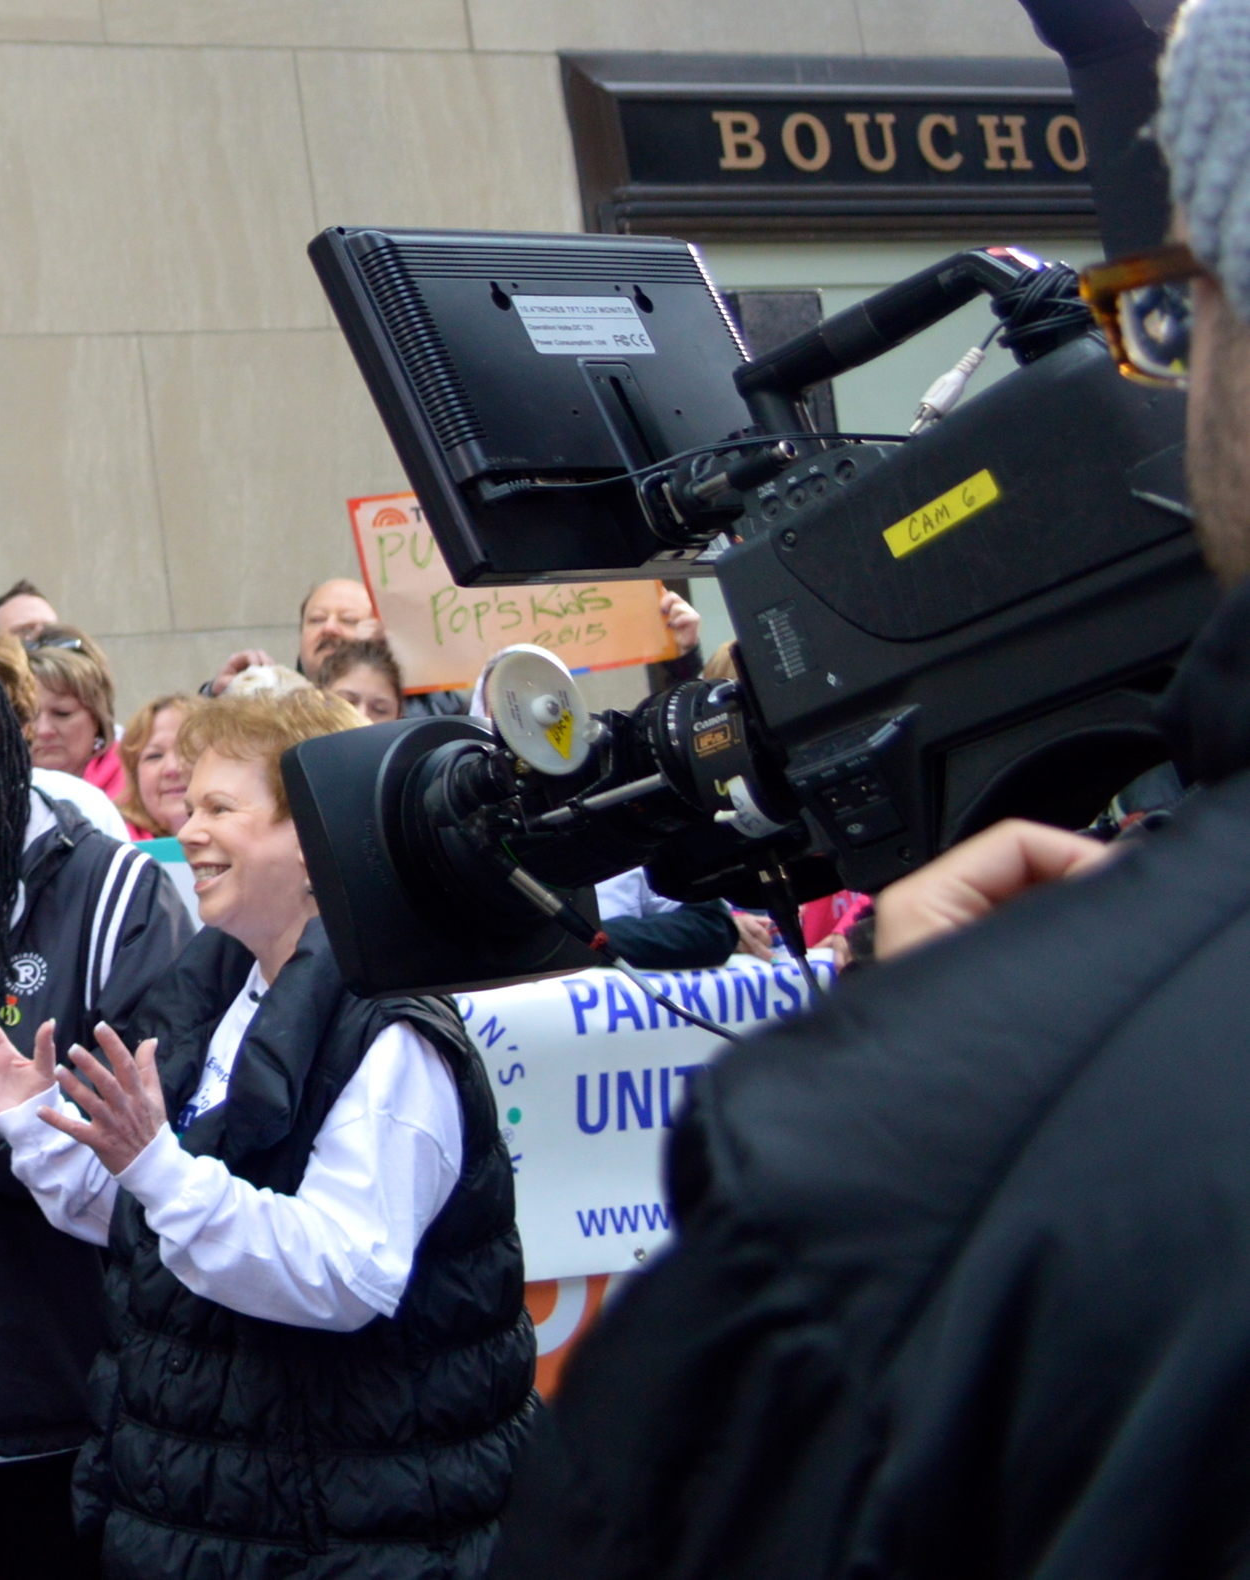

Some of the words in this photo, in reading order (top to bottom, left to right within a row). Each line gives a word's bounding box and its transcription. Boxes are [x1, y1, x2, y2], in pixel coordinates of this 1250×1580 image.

[712, 110, 1087, 172] BOUCHO
[566, 306, 581, 314] TFT
[582, 306, 598, 314] LCD
[600, 306, 634, 314] MONITOR
[908, 503, 951, 542] CAM
[961, 486, 977, 508] 6
[693, 712, 729, 732] Canon
